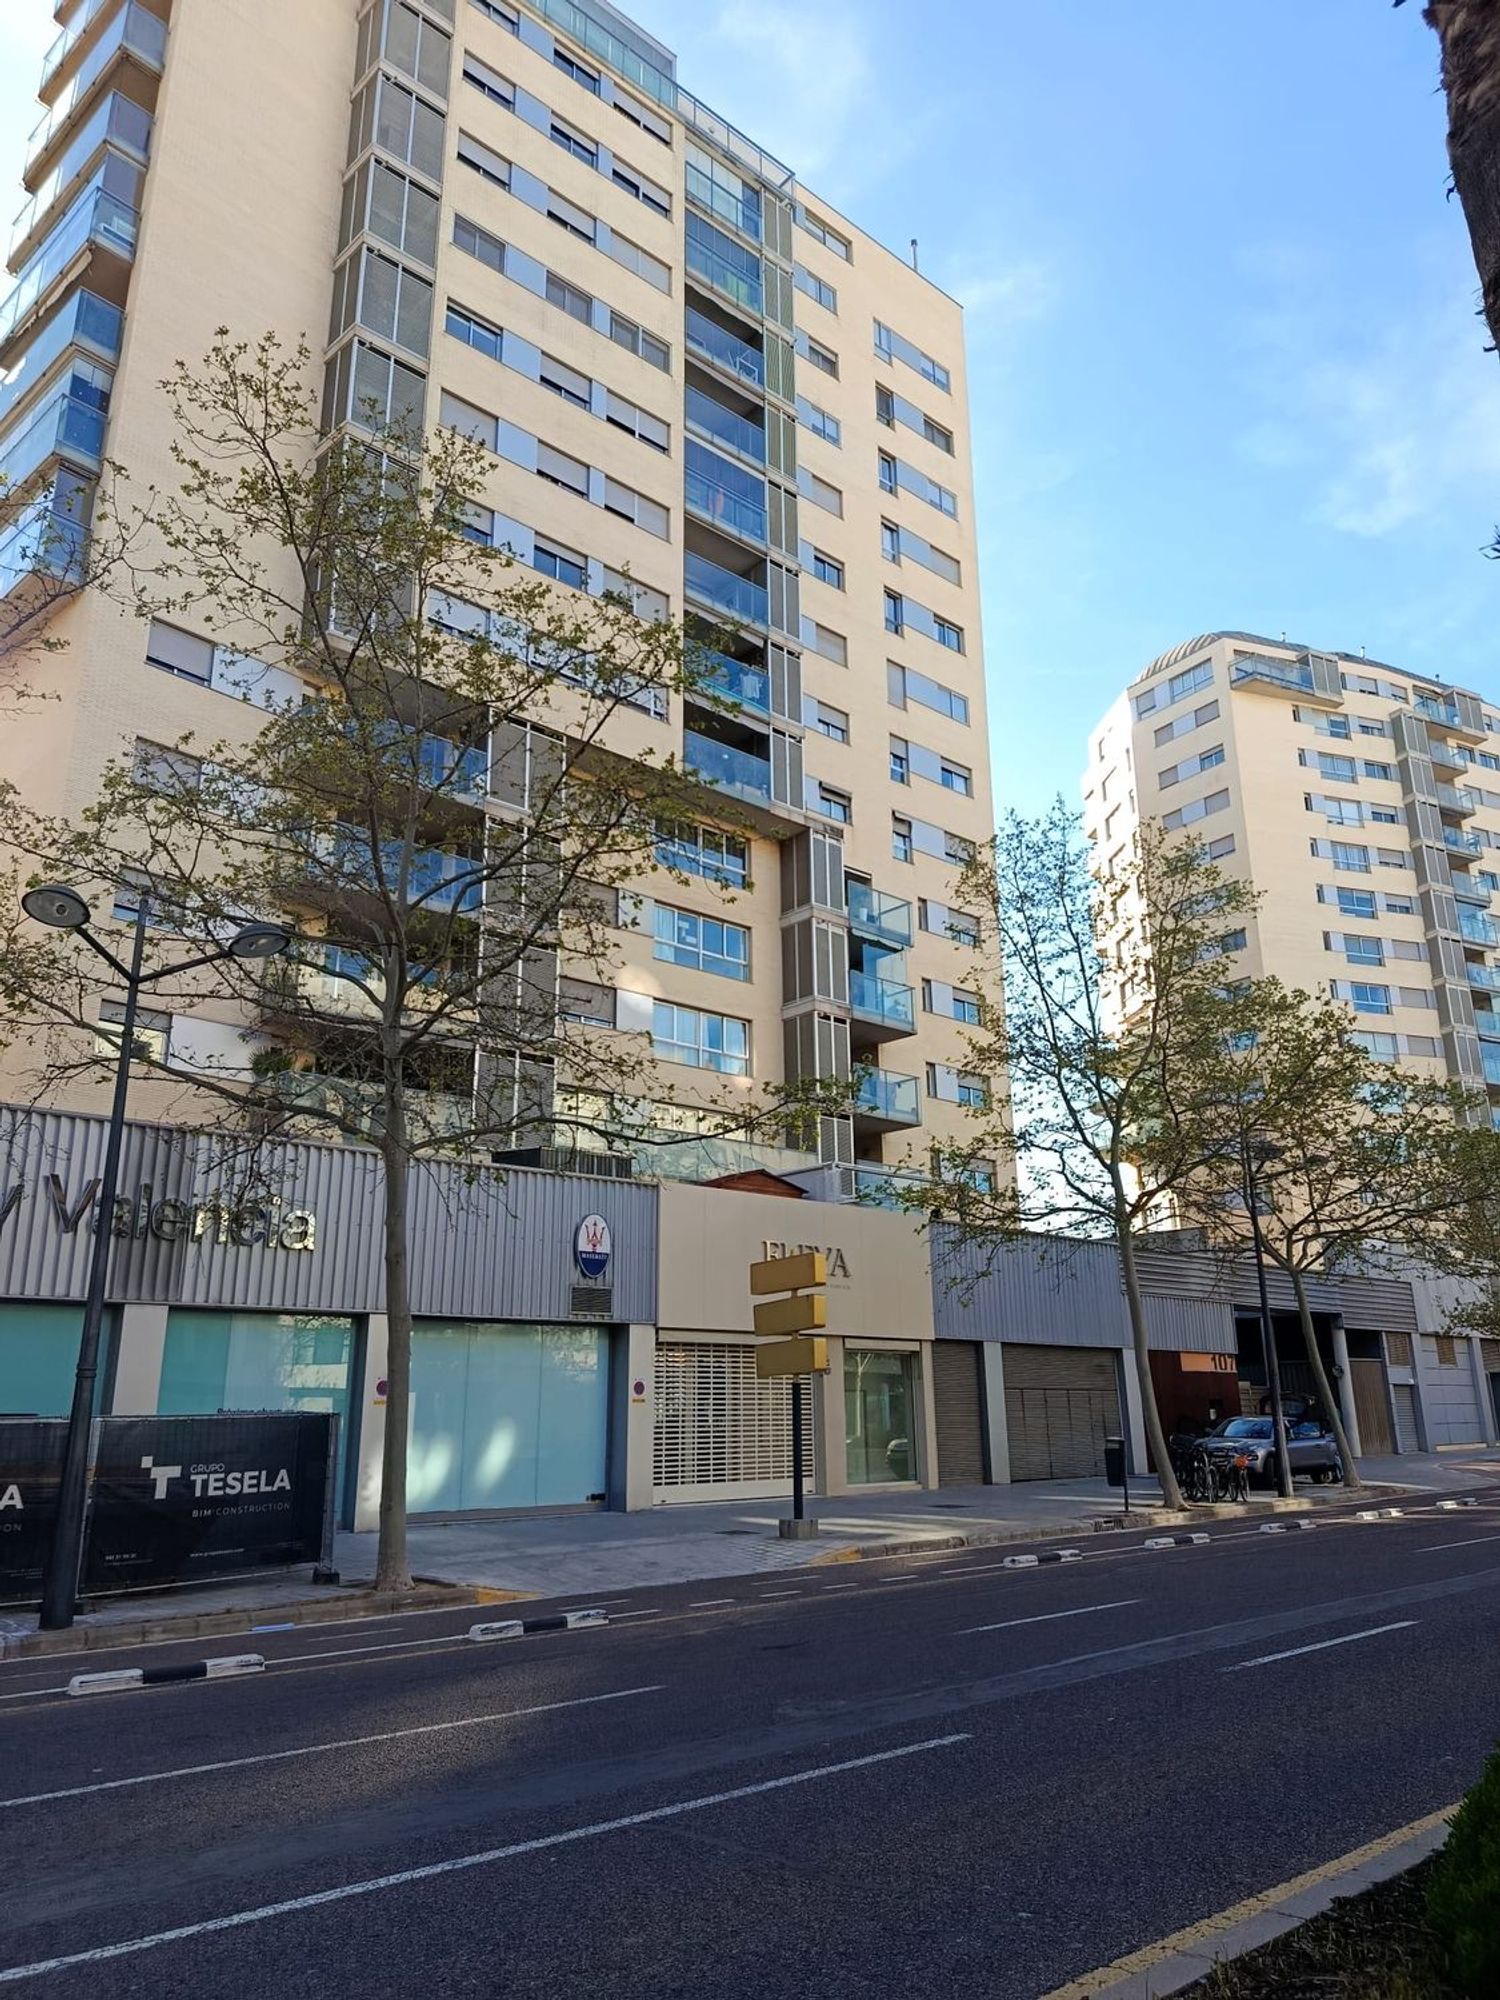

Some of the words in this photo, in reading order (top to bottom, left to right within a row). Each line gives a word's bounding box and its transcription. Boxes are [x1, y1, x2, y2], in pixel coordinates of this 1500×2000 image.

[1210, 1354, 1234, 1371] 107
[190, 1463, 225, 1473] GRUPO
[190, 1468, 291, 1497] TESELA
[192, 1508, 212, 1518] BIM
[215, 1502, 290, 1516] CONSTRUCTION
